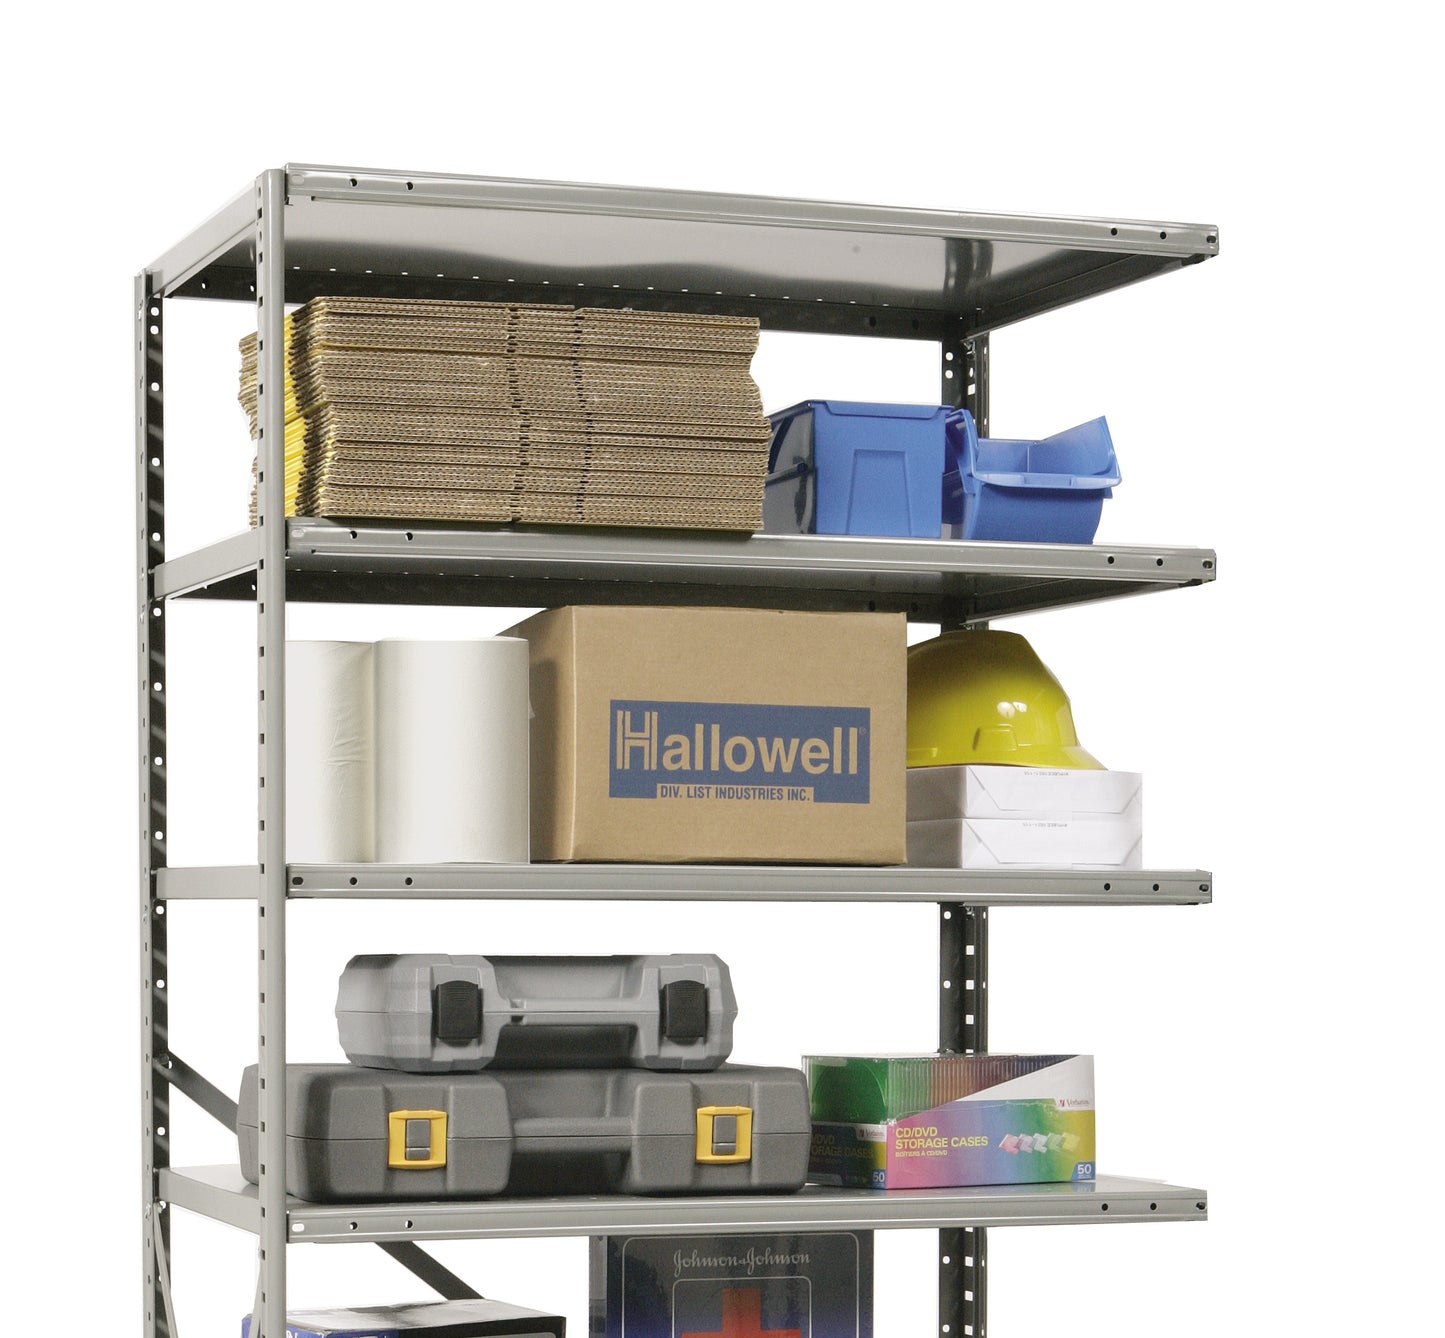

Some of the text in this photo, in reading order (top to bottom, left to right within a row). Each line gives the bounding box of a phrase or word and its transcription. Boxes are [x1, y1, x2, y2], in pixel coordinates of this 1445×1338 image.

[615, 709, 859, 776] Hallowell
[660, 785, 810, 801] DIV. LIST INDUSTRIES INC.
[895, 1127, 938, 1138] CD/DVD
[895, 1136, 989, 1149] STORAGE CASES
[1077, 1164, 1092, 1175] 50
[873, 1172, 885, 1183] 50
